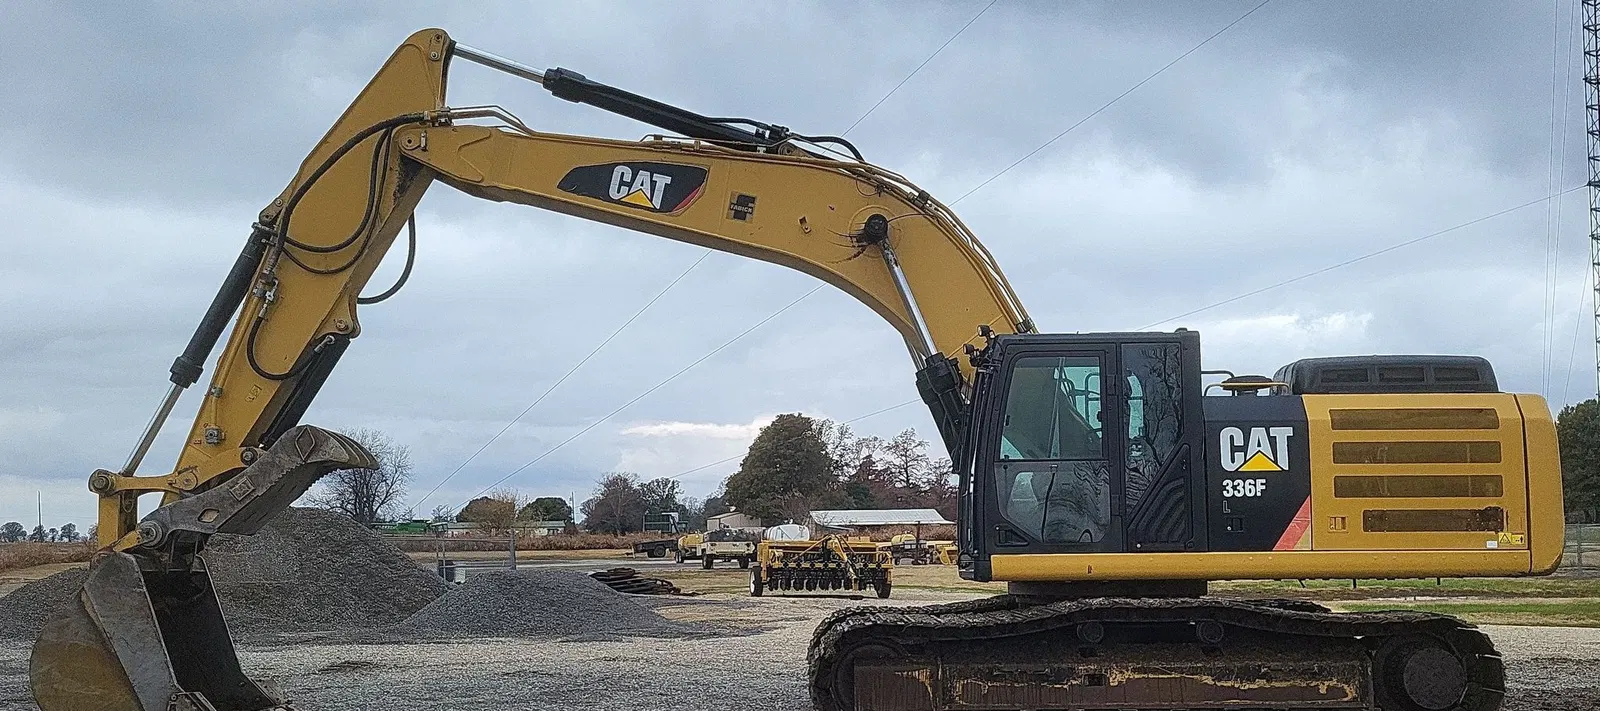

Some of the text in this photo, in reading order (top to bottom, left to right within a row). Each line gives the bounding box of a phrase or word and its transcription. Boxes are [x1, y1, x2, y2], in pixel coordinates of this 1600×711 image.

[609, 165, 672, 209] CAT
[1220, 427, 1293, 472] CAT
[1222, 479, 1266, 497] 336F
